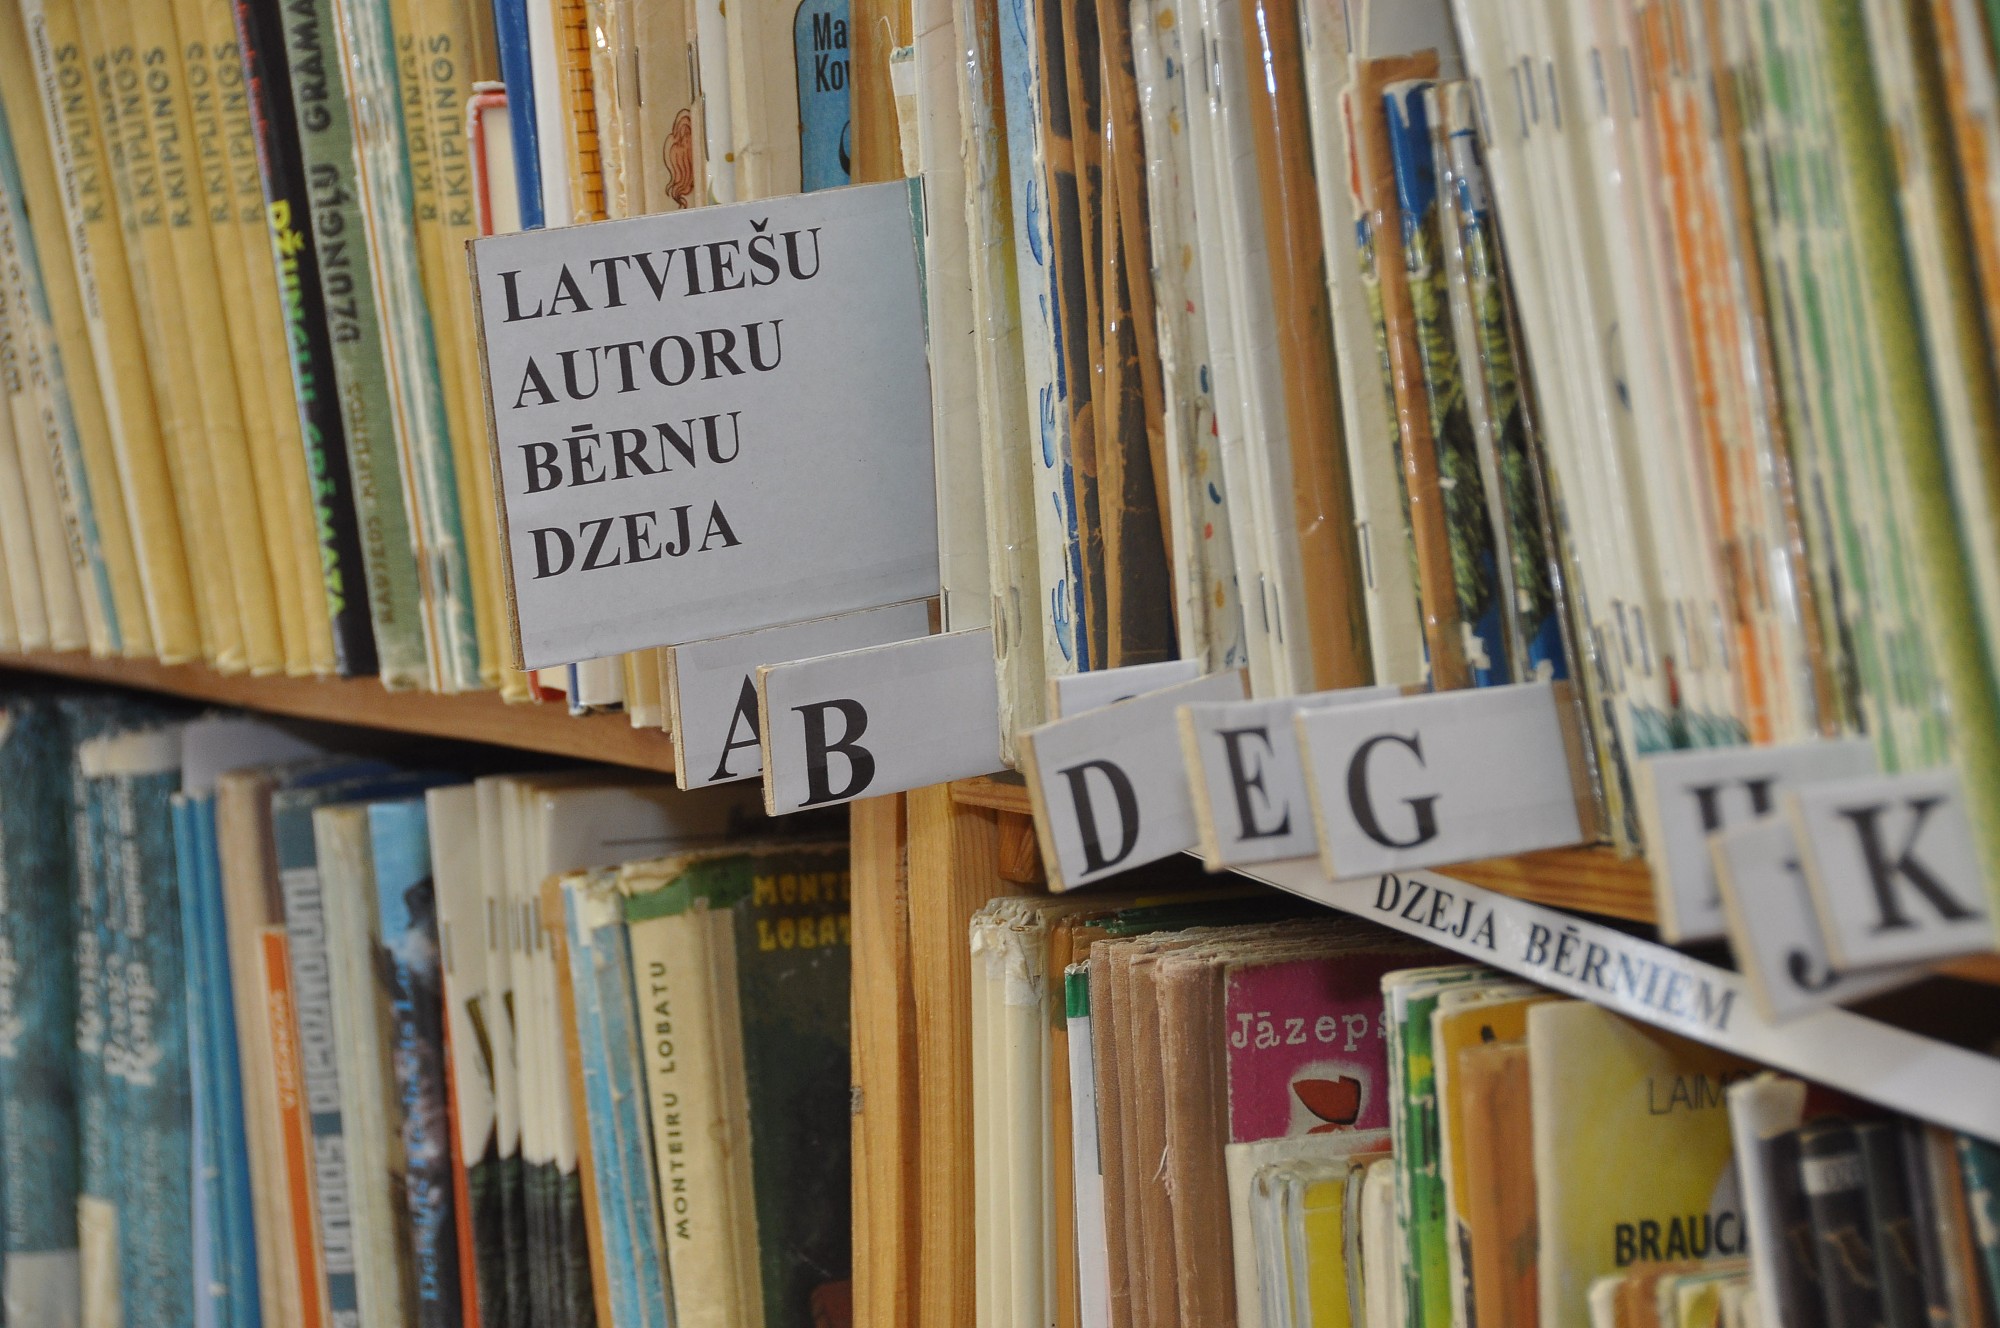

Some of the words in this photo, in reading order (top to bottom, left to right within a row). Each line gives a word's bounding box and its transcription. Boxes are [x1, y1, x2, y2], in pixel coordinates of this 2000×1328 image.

[812, 12, 848, 51] Ma
[497, 217, 822, 324] LATVIEŠU
[512, 319, 784, 410] AUTORU
[518, 410, 742, 494] BĒRNU
[528, 499, 742, 580] DZEJA
[708, 674, 764, 782] A
[791, 699, 876, 808] B
[1057, 759, 1141, 877] D
[1215, 726, 1292, 843] E
[1345, 729, 1443, 850] G
[1374, 872, 1499, 953] DZEJA
[1835, 792, 1988, 937] K
[649, 961, 677, 1073] LOBATU
[1520, 920, 1740, 1032] BĒRNIEM
[662, 1091, 693, 1241] MONTEIRU
